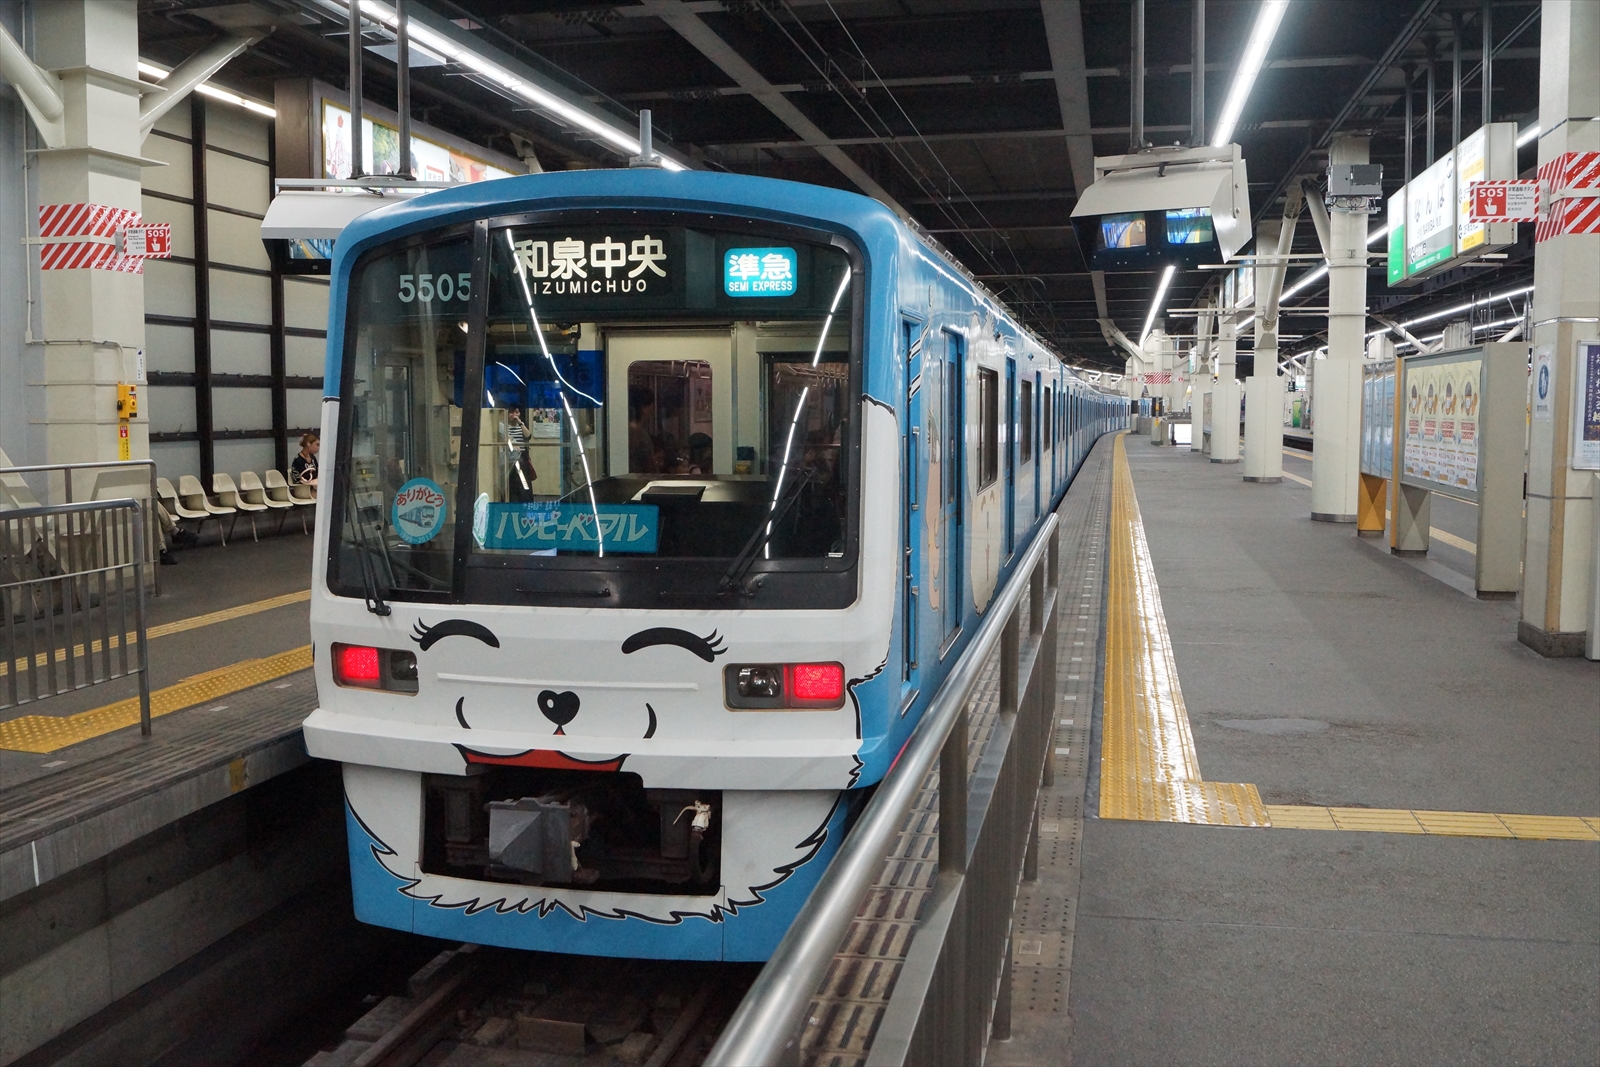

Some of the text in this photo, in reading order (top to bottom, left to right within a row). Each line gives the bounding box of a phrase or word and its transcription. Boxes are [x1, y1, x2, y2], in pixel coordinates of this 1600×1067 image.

[1414, 177, 1445, 223] なんば
[1479, 188, 1504, 198] SOS
[147, 229, 164, 238] SOS
[513, 234, 667, 279] 和泉中央
[729, 252, 793, 281] 準急
[398, 273, 472, 303] 5505
[533, 279, 647, 295] IZUMICHUO
[728, 280, 793, 292] SEMI EXPRESS
[396, 487, 445, 508] ありがとう
[494, 511, 649, 542] ハッピーベアル
